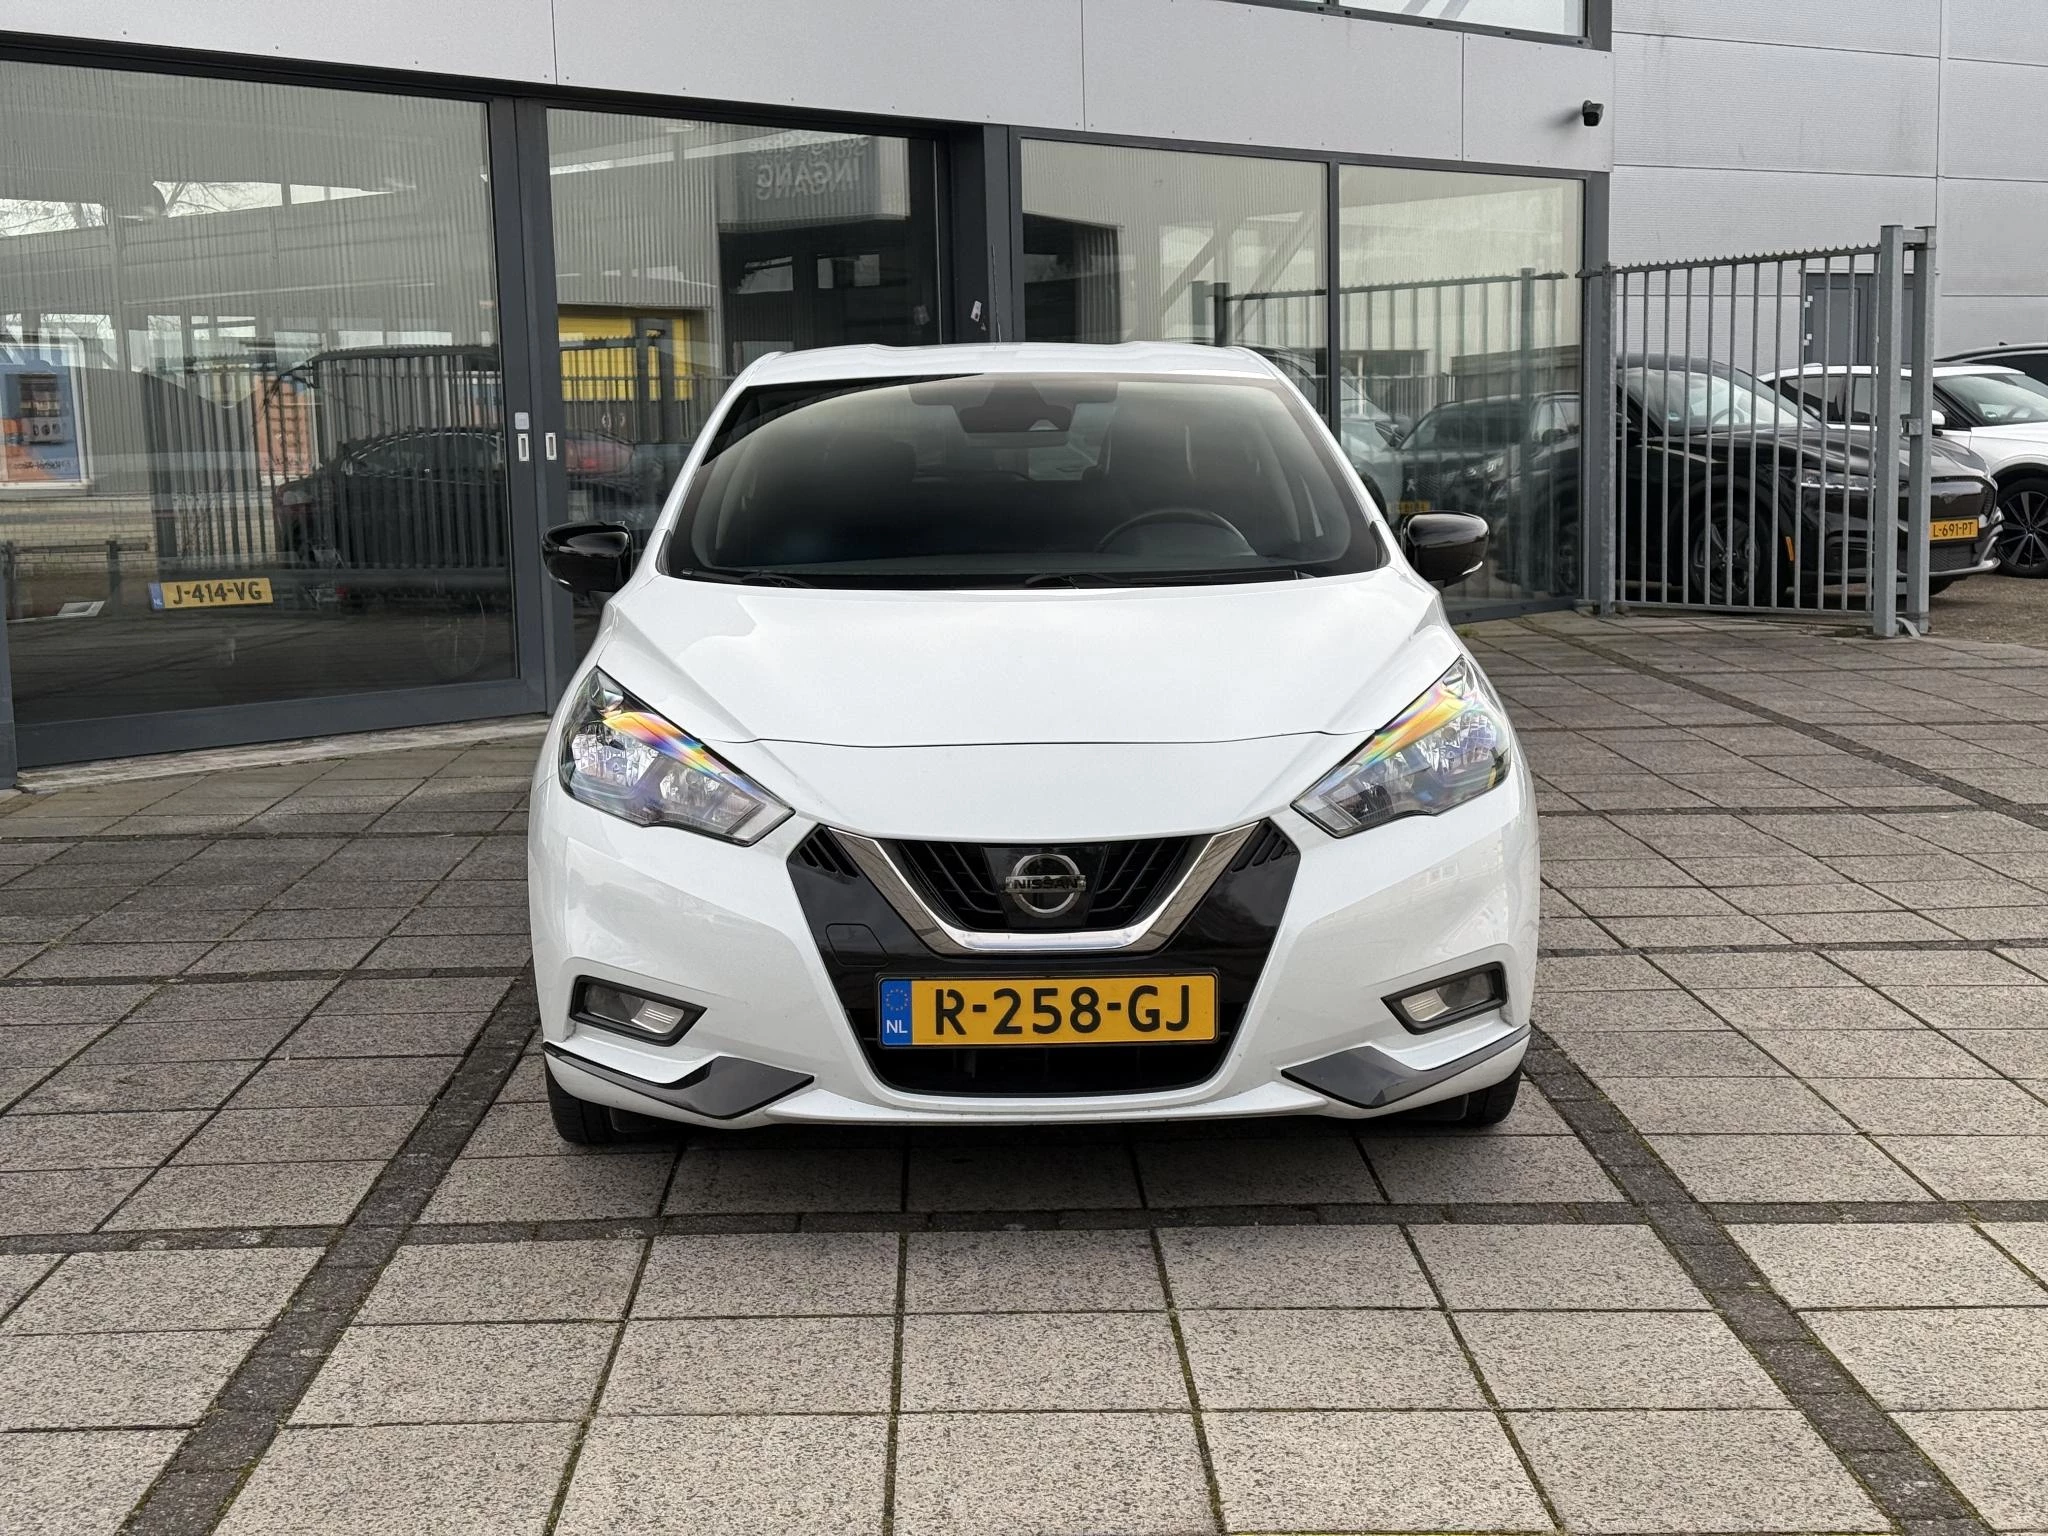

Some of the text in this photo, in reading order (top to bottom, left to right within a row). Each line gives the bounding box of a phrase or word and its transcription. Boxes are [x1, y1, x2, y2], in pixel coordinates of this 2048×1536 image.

[1933, 522, 1973, 537] L-691-PT
[173, 581, 262, 604] J-414-VG
[1013, 877, 1078, 889] NISSAN
[934, 985, 1190, 1035] R-258-GJ
[886, 1020, 908, 1034] NL
